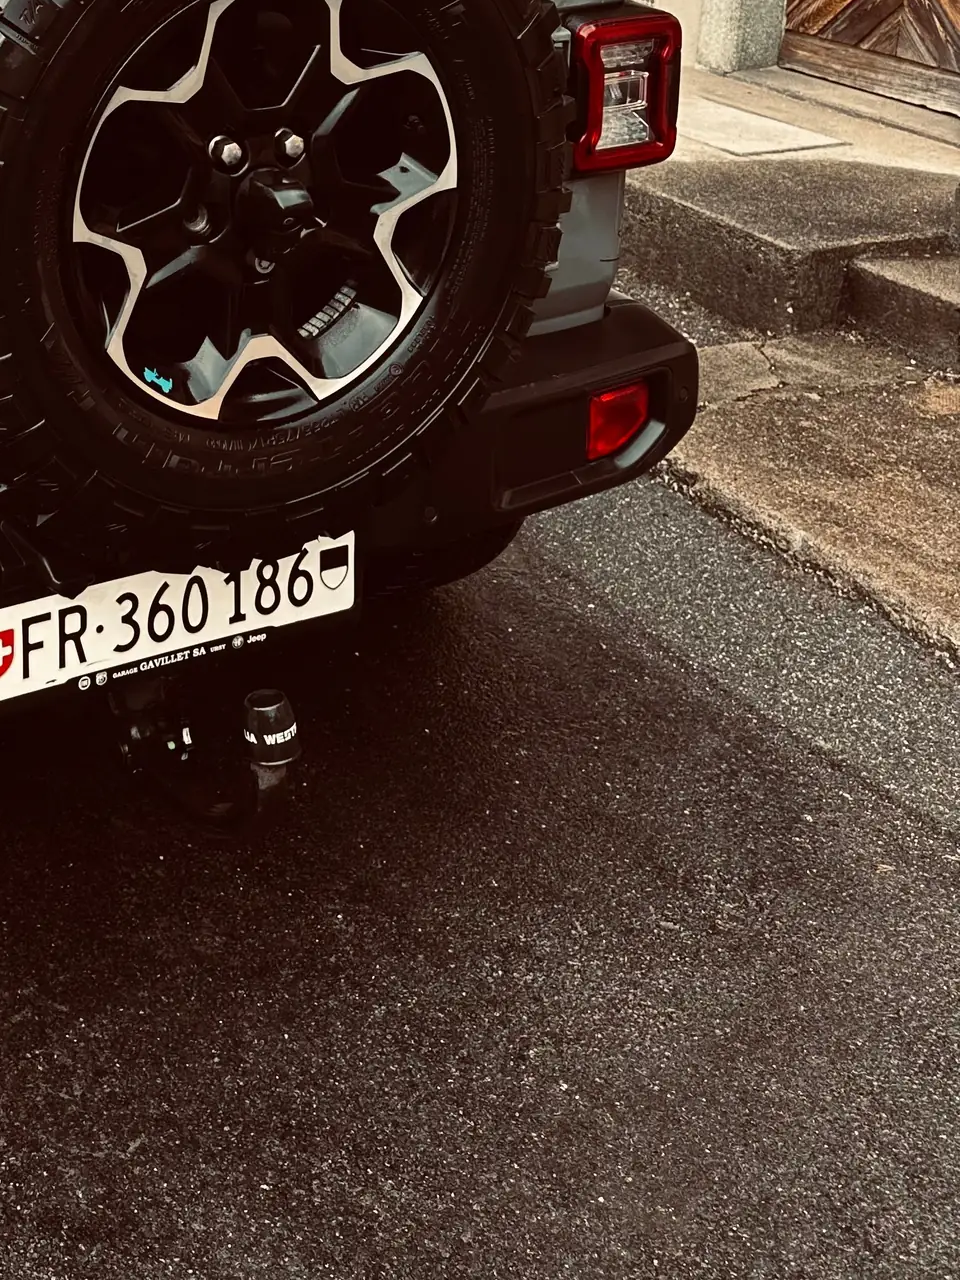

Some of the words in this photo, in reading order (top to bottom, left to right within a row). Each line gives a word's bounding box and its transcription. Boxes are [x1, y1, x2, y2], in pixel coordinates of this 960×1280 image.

[246, 633, 267, 644] Jeep
[112, 667, 139, 679] GARAGE
[140, 650, 191, 671] GAVILLET
[192, 646, 207, 658] SA
